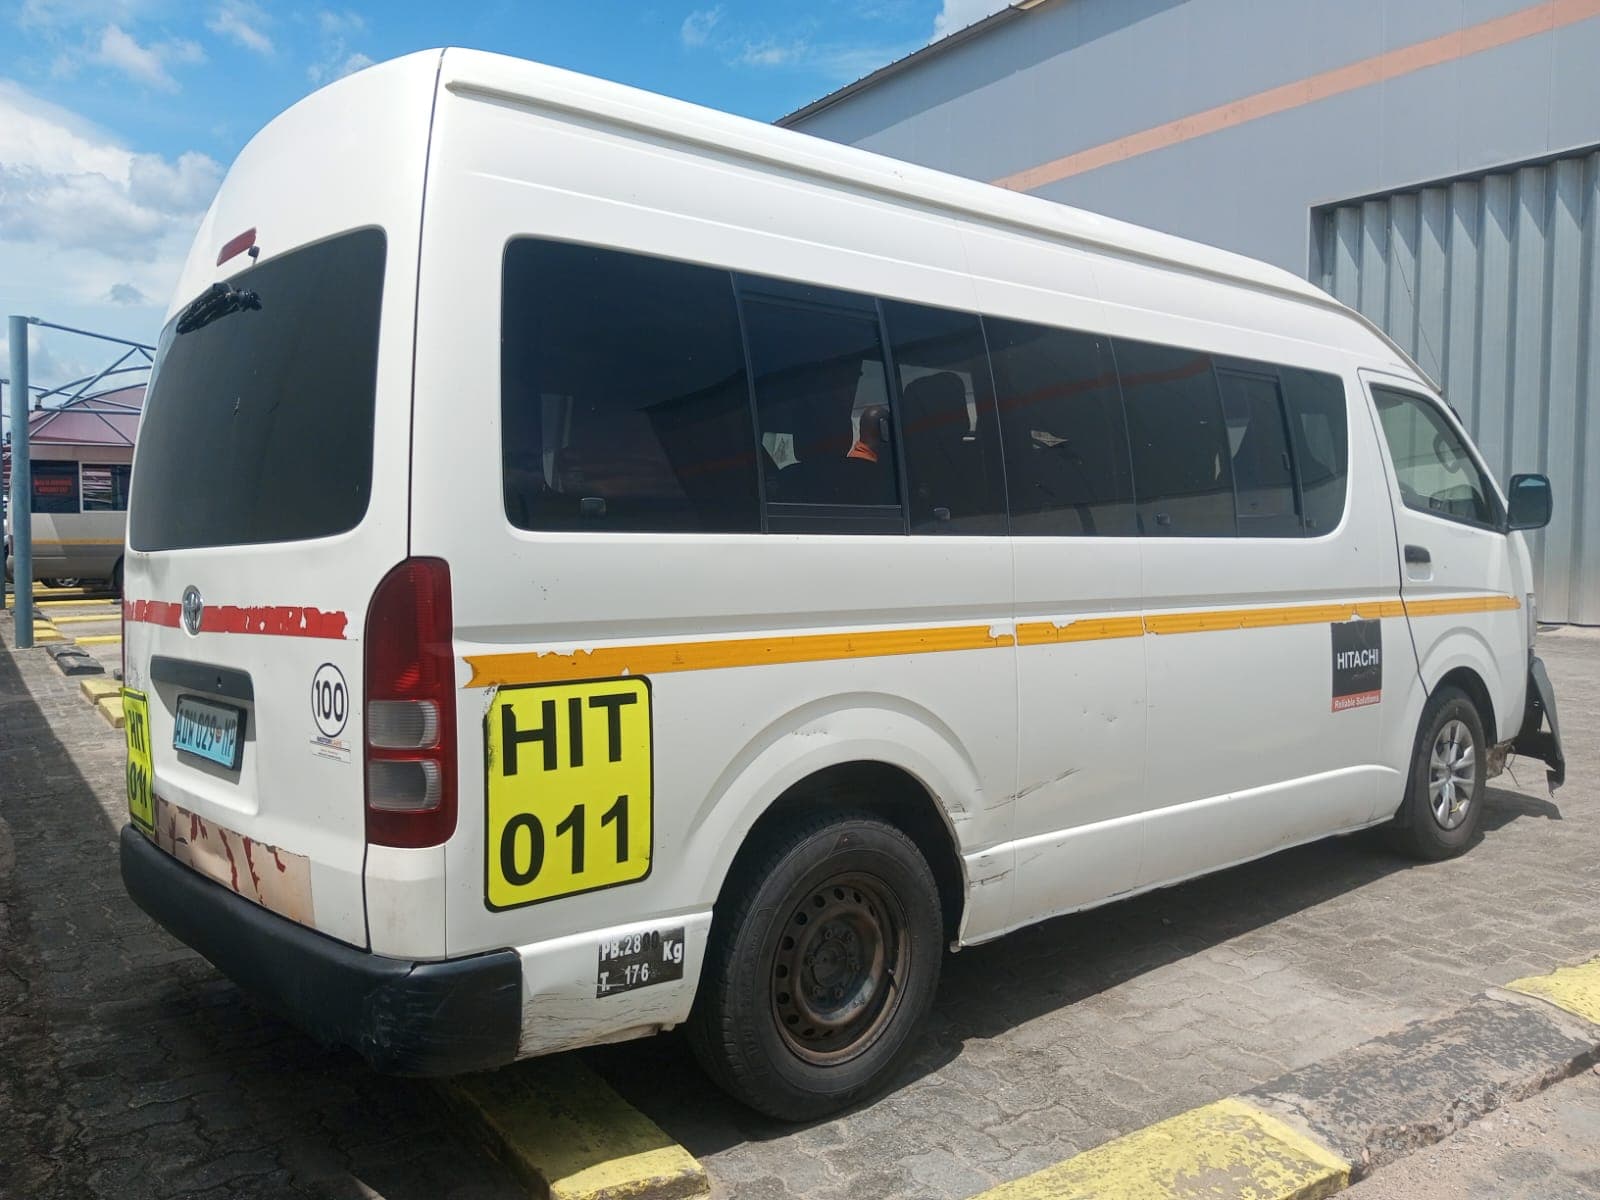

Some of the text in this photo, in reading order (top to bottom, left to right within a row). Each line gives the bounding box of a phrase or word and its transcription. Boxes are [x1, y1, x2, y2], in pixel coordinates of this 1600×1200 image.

[1336, 649, 1379, 670] HITACHI
[315, 679, 346, 722] 100
[1334, 697, 1356, 710] Reliable
[128, 709, 146, 754] HIT
[501, 692, 638, 776] HIT
[129, 761, 148, 809] 011
[500, 795, 629, 887] 011
[663, 940, 683, 964] Kg
